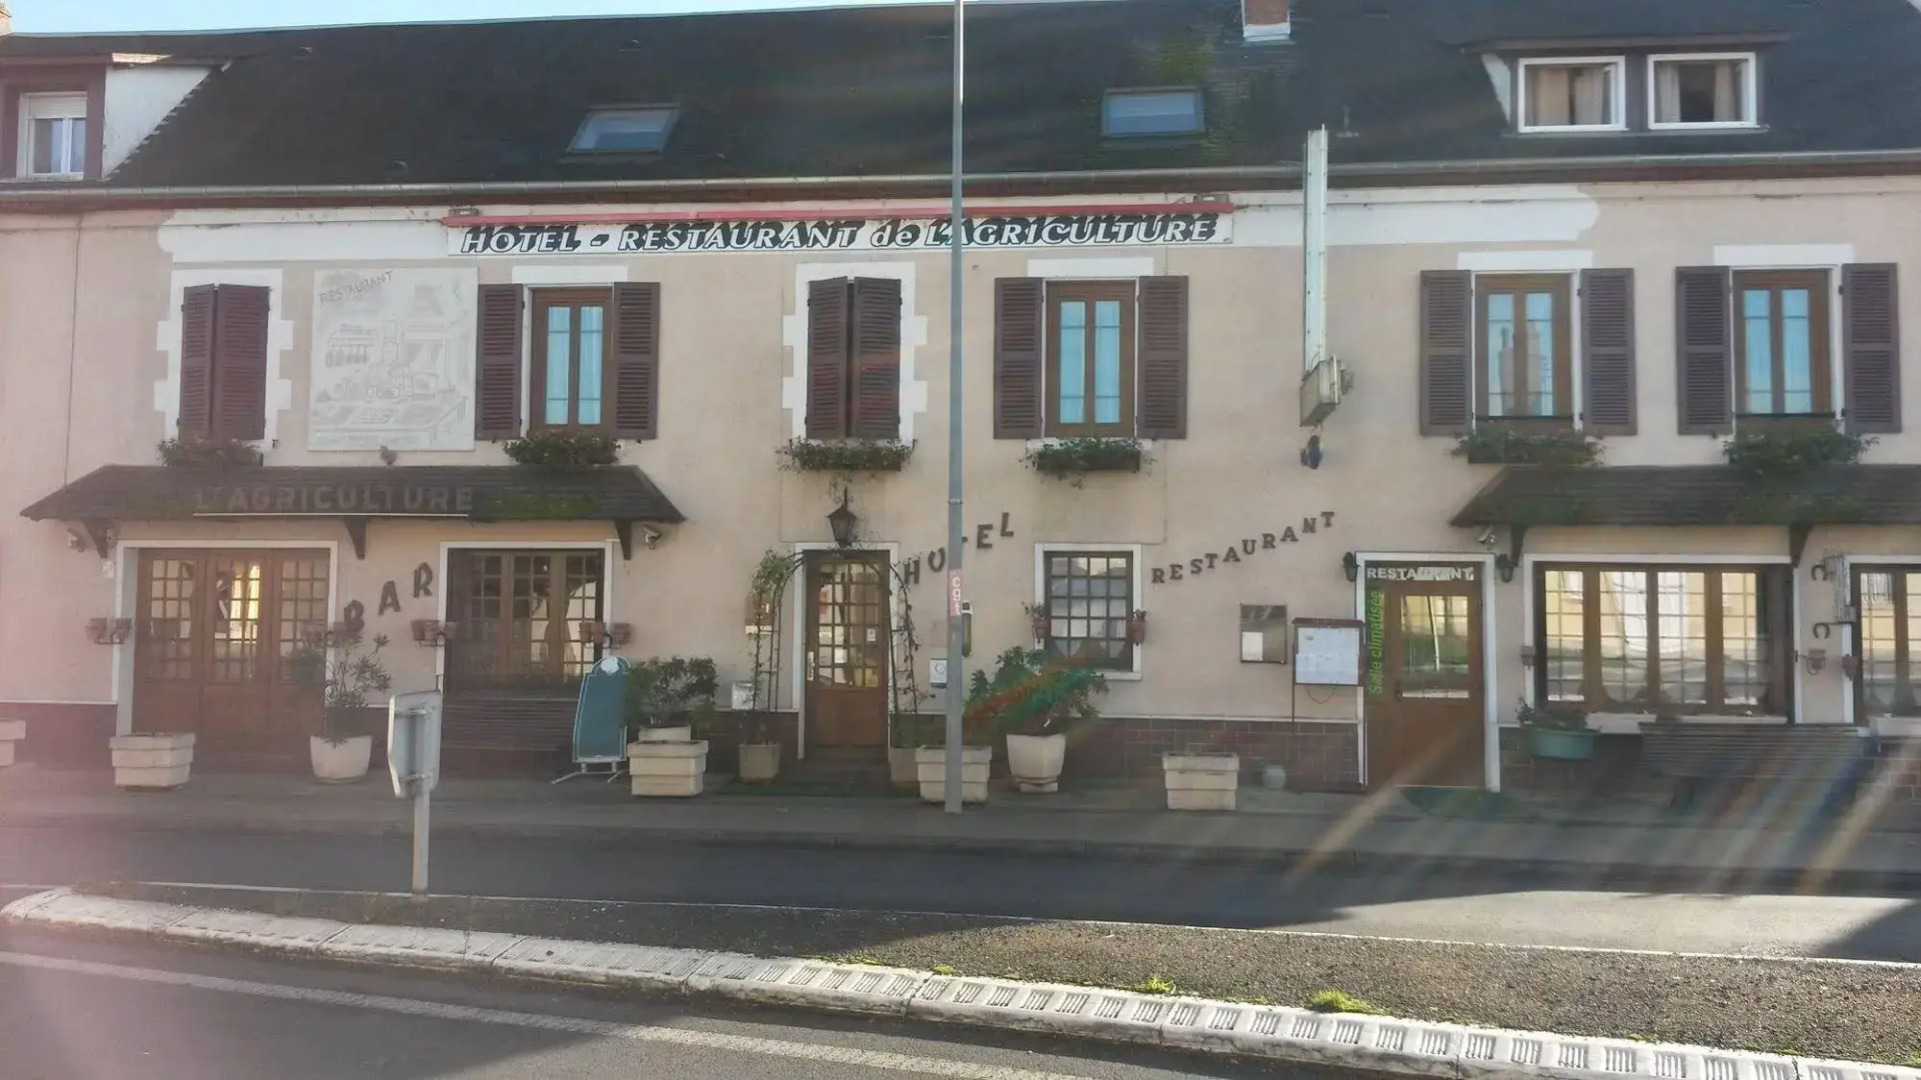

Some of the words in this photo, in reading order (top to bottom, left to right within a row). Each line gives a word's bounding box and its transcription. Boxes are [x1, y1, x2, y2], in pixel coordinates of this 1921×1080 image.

[461, 223, 580, 252] HOTEL
[618, 219, 867, 250] RESTAURANT
[870, 219, 921, 247] de
[904, 512, 1015, 585] HOEL
[1151, 511, 1335, 584] RESTAURANT
[343, 562, 434, 634] BAR
[952, 576, 961, 616] cgt
